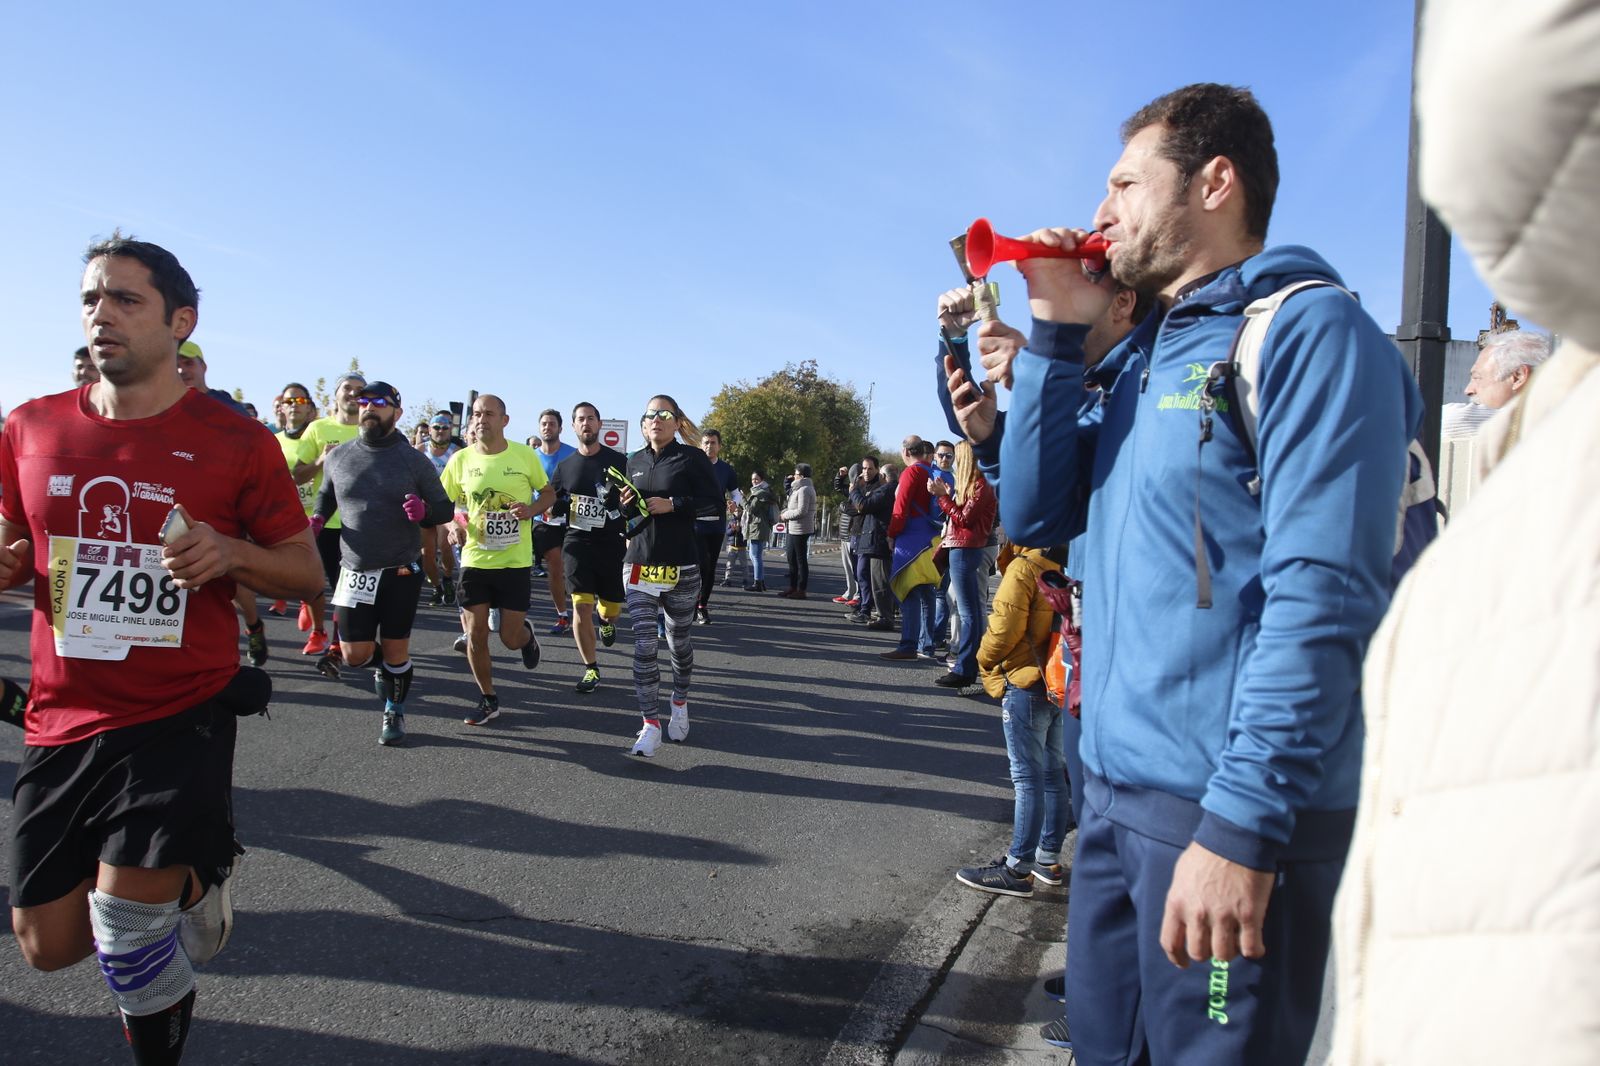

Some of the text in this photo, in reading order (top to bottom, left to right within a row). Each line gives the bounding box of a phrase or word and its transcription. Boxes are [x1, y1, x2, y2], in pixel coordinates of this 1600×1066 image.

[140, 490, 174, 504] GRANADA
[577, 503, 605, 518] 6834
[486, 519, 519, 535] 6532
[78, 554, 107, 562] IMDECO
[641, 565, 678, 580] 3413
[54, 570, 66, 614] CAJÓN
[77, 567, 180, 616] 7498
[66, 611, 179, 627] JOSE MIGUEL PINEL UBAGO
[115, 633, 150, 642] Cruzcampo
